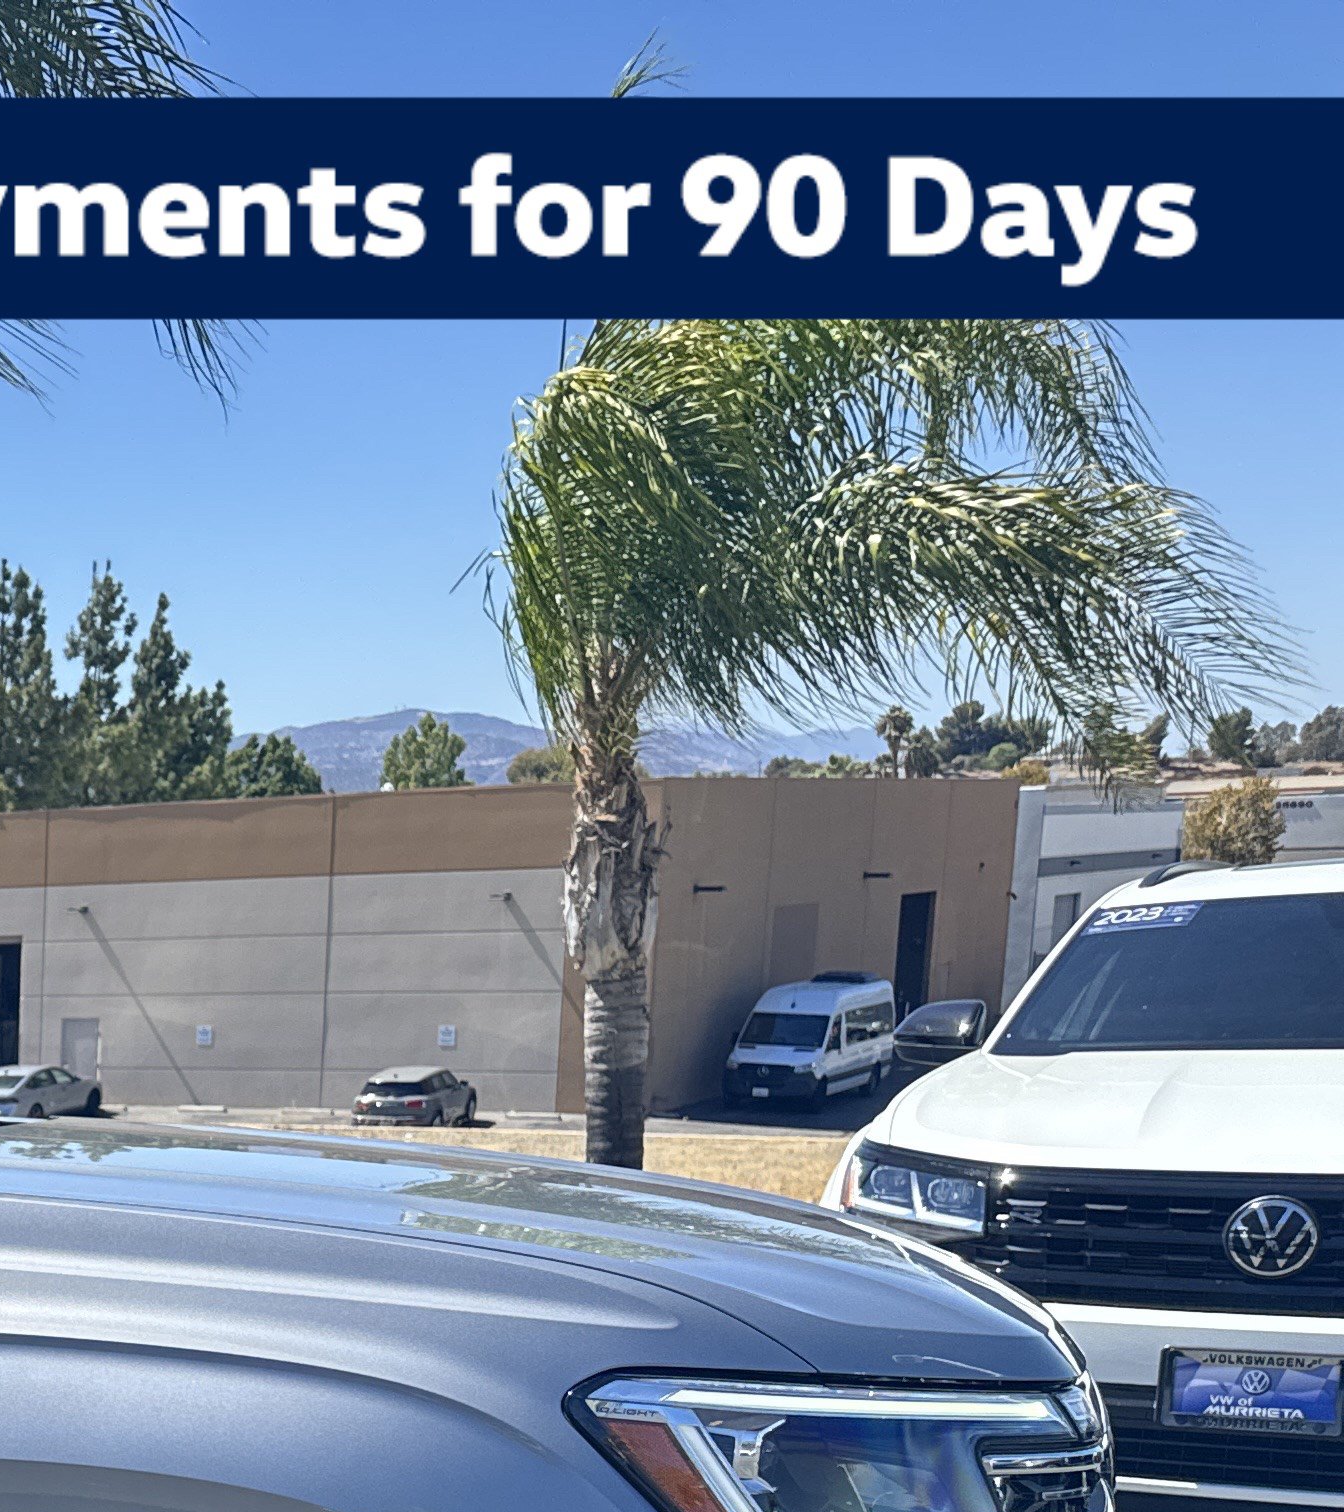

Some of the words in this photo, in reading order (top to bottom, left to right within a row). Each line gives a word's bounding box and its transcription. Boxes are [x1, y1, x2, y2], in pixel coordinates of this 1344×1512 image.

[1094, 906, 1165, 926] 2023
[1208, 1353, 1306, 1368] VOLKSWAGEN
[1210, 1395, 1232, 1405] VW
[1238, 1395, 1254, 1406] of
[1202, 1405, 1305, 1419] MURRIETA
